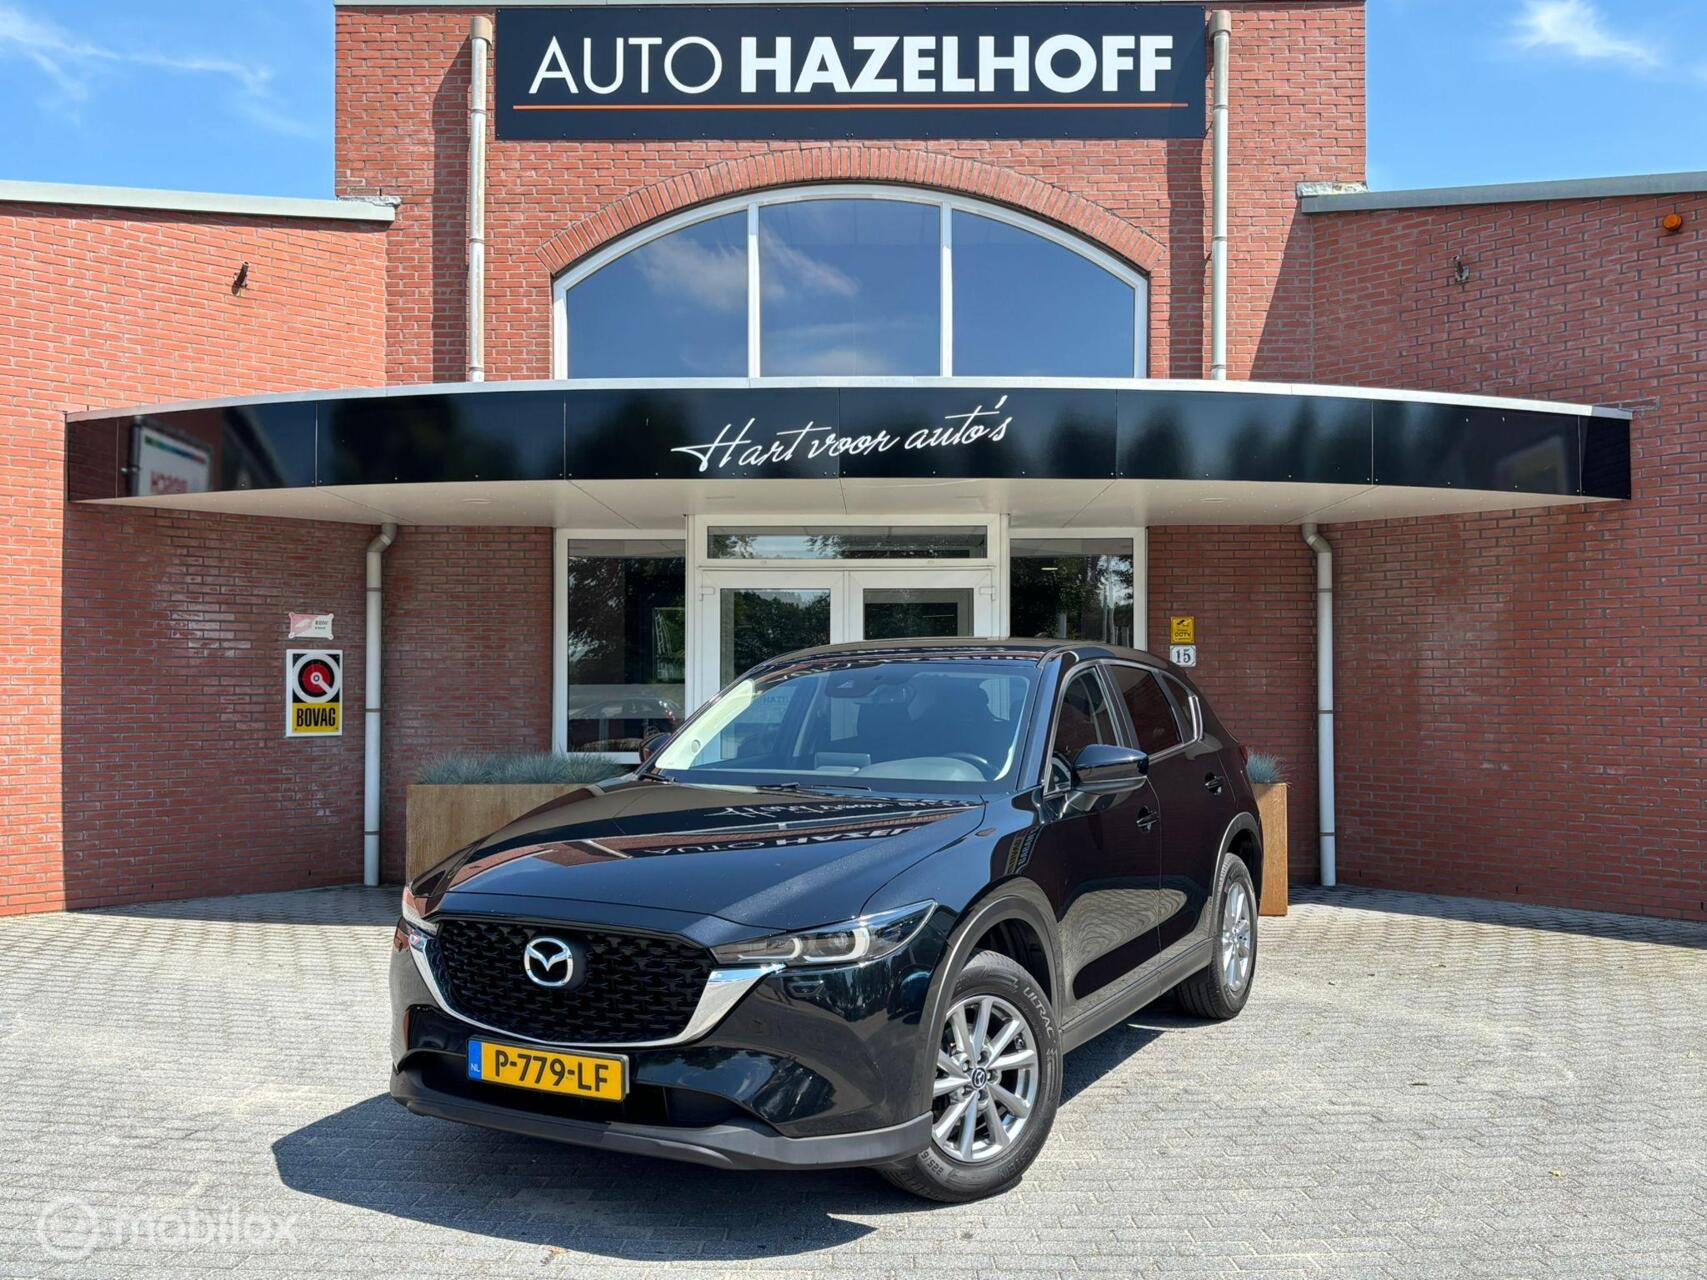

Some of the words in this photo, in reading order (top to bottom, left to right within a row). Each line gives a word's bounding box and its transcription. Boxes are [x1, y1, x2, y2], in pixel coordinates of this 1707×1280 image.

[528, 34, 722, 96] AUTO
[740, 33, 1173, 94] HAZELHOFF
[670, 417, 832, 472] Hart
[807, 429, 900, 460] voor
[903, 395, 1014, 450] auto's
[1175, 648, 1191, 664] 15
[296, 707, 336, 727] BOVAG
[470, 1063, 481, 1073] NL
[494, 1049, 609, 1092] P-779-LF
